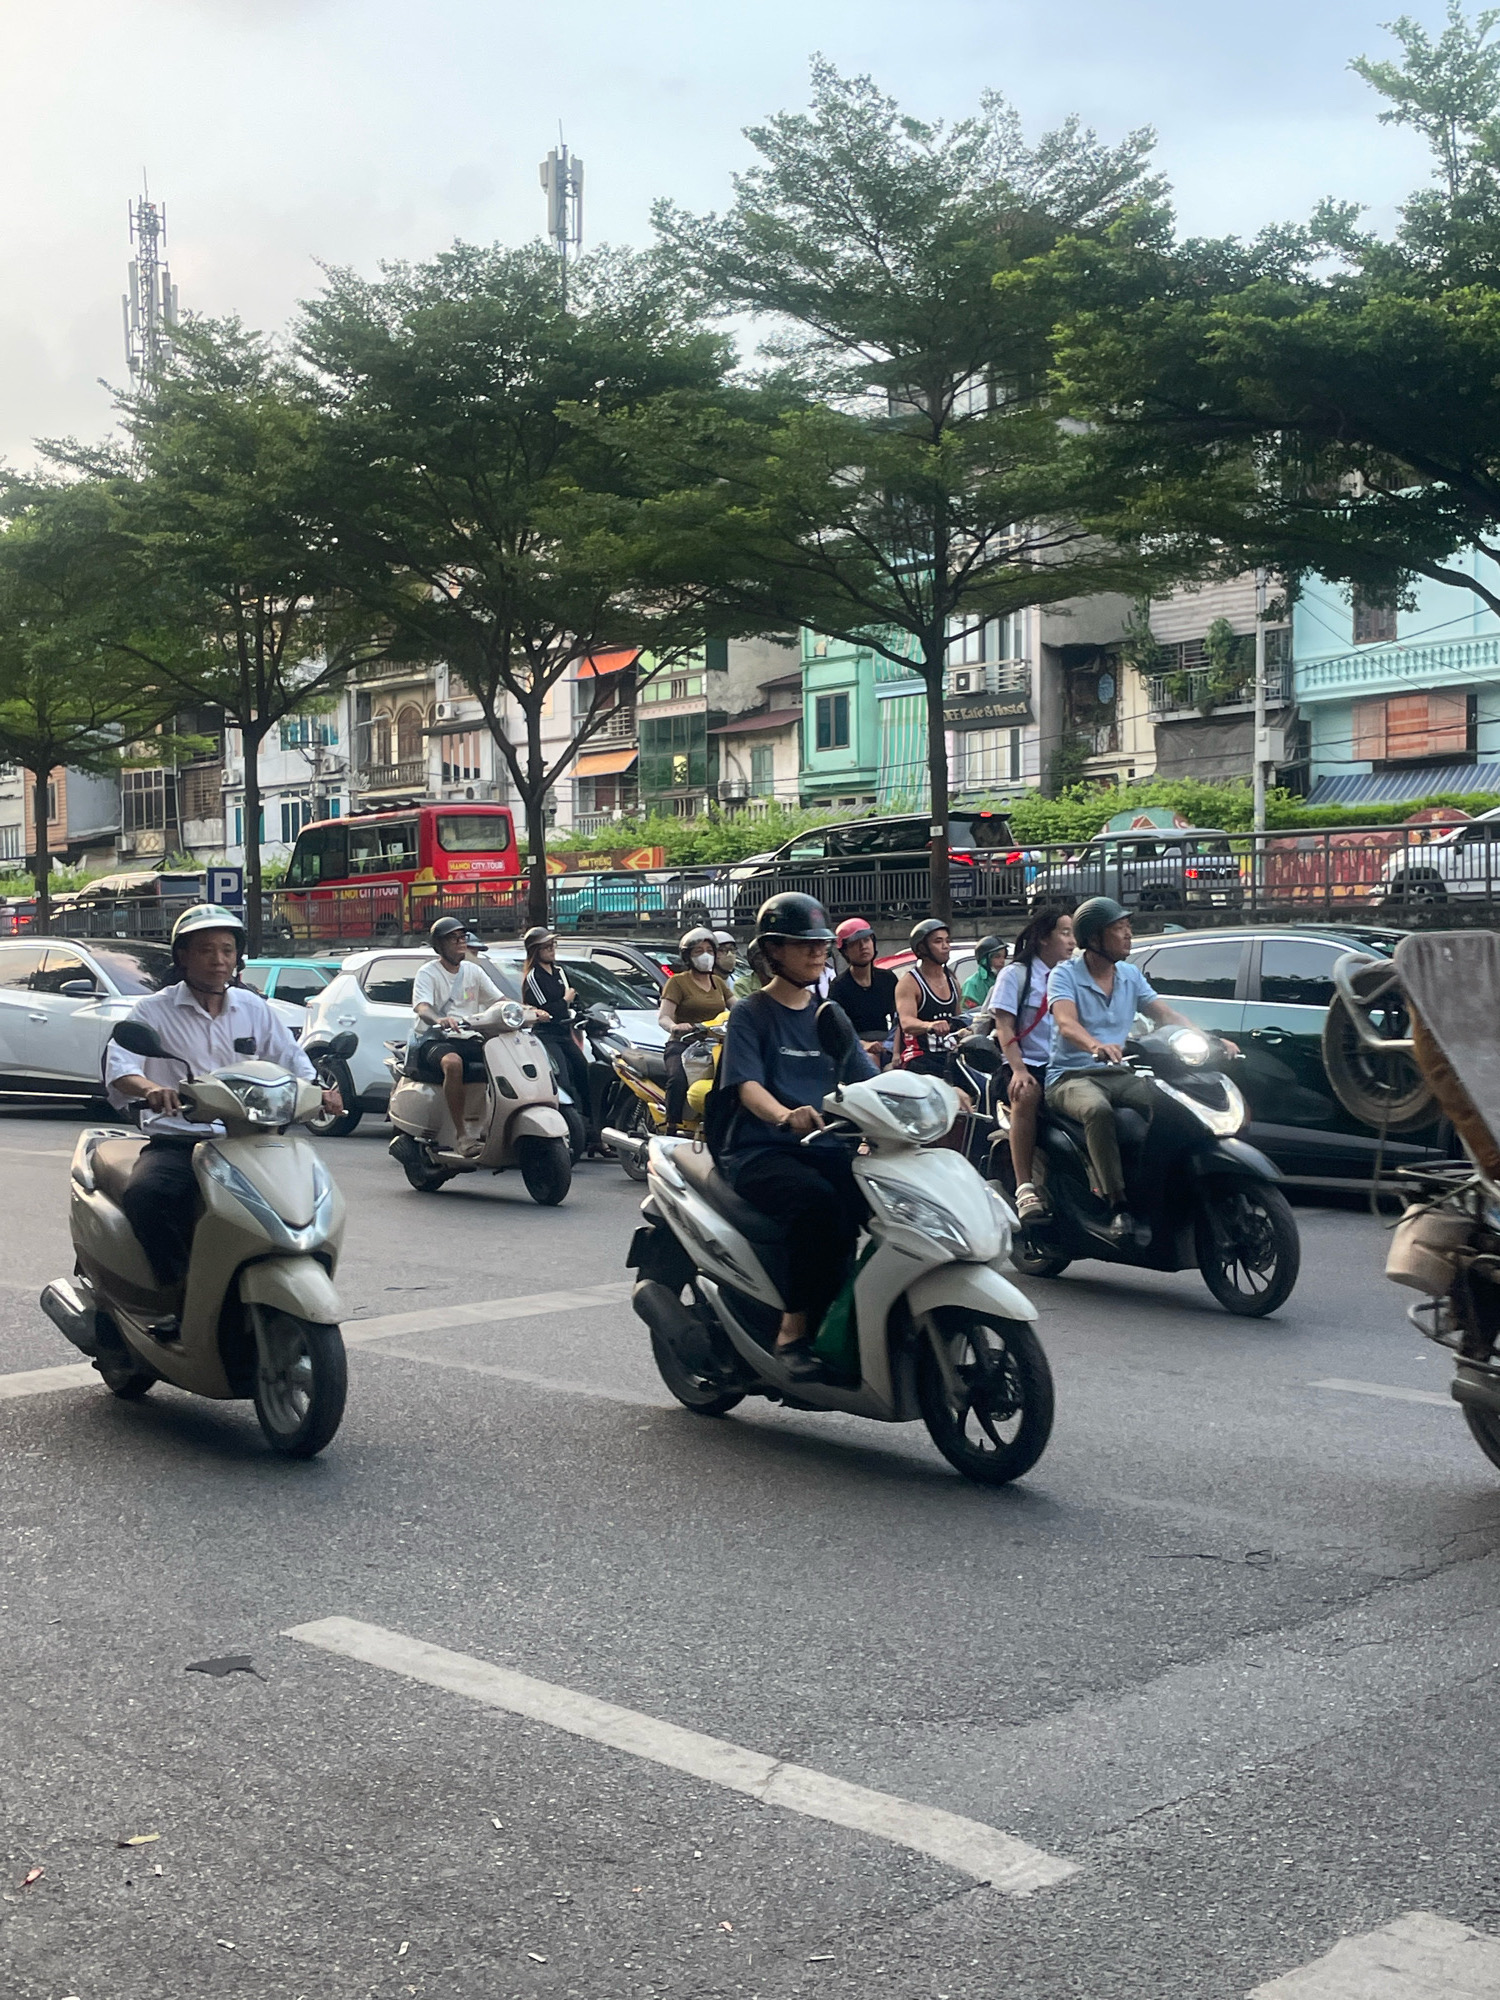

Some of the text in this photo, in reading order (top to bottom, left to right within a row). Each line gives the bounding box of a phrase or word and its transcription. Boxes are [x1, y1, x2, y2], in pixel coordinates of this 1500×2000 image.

[984, 705, 994, 718] &
[471, 862, 486, 870] CITY
[487, 861, 504, 869] TOUR
[214, 872, 238, 903] P
